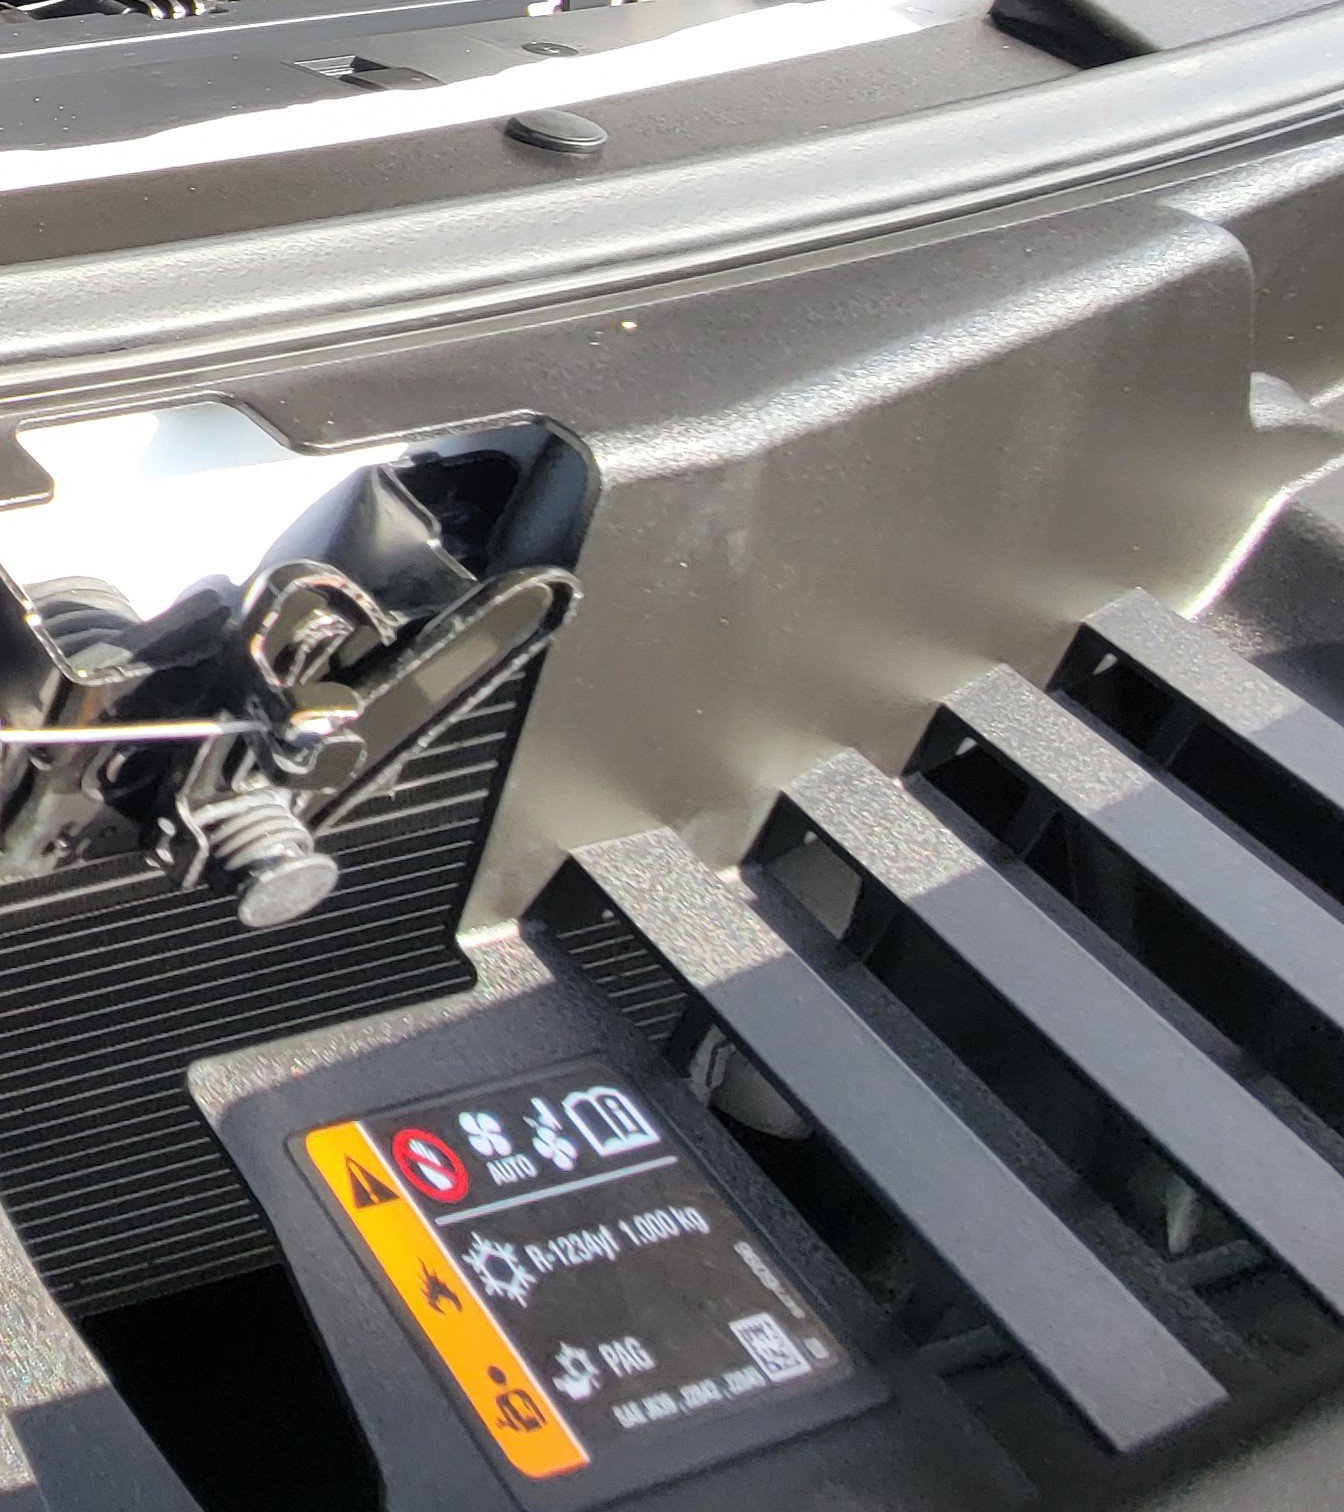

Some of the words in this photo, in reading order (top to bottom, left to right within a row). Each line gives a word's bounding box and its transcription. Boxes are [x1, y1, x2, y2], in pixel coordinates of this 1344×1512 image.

[486, 1153, 538, 1185] AUTO
[524, 1224, 621, 1273] R-1234yf
[618, 1209, 680, 1246] 1.000
[669, 1205, 710, 1234] kg
[598, 1335, 655, 1377] PAG
